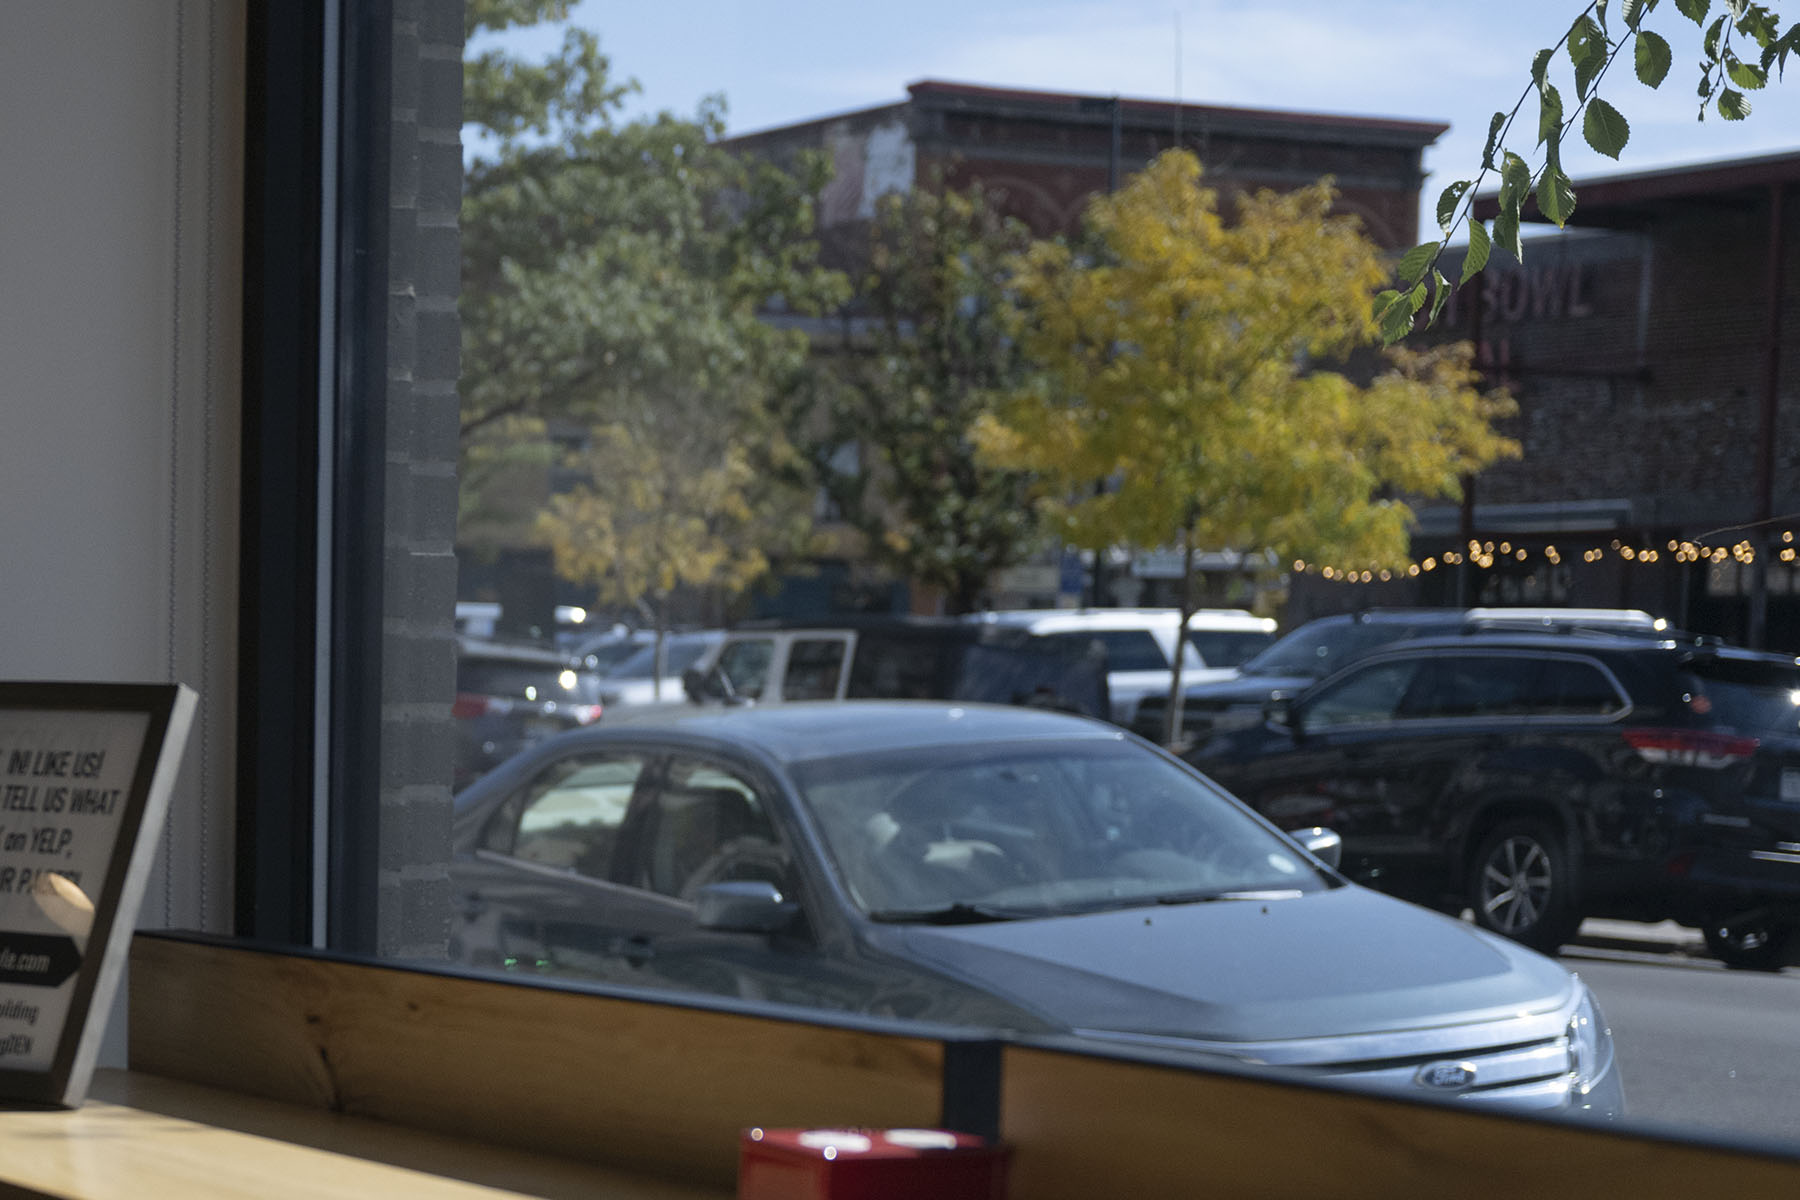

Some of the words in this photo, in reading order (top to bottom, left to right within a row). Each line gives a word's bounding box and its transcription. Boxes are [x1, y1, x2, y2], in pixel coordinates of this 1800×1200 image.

[32, 750, 72, 778] LIKE
[72, 750, 106, 779] US!
[3, 784, 39, 812] TELL
[42, 786, 68, 814] US
[69, 788, 121, 816] WHAT
[4, 832, 28, 853] on
